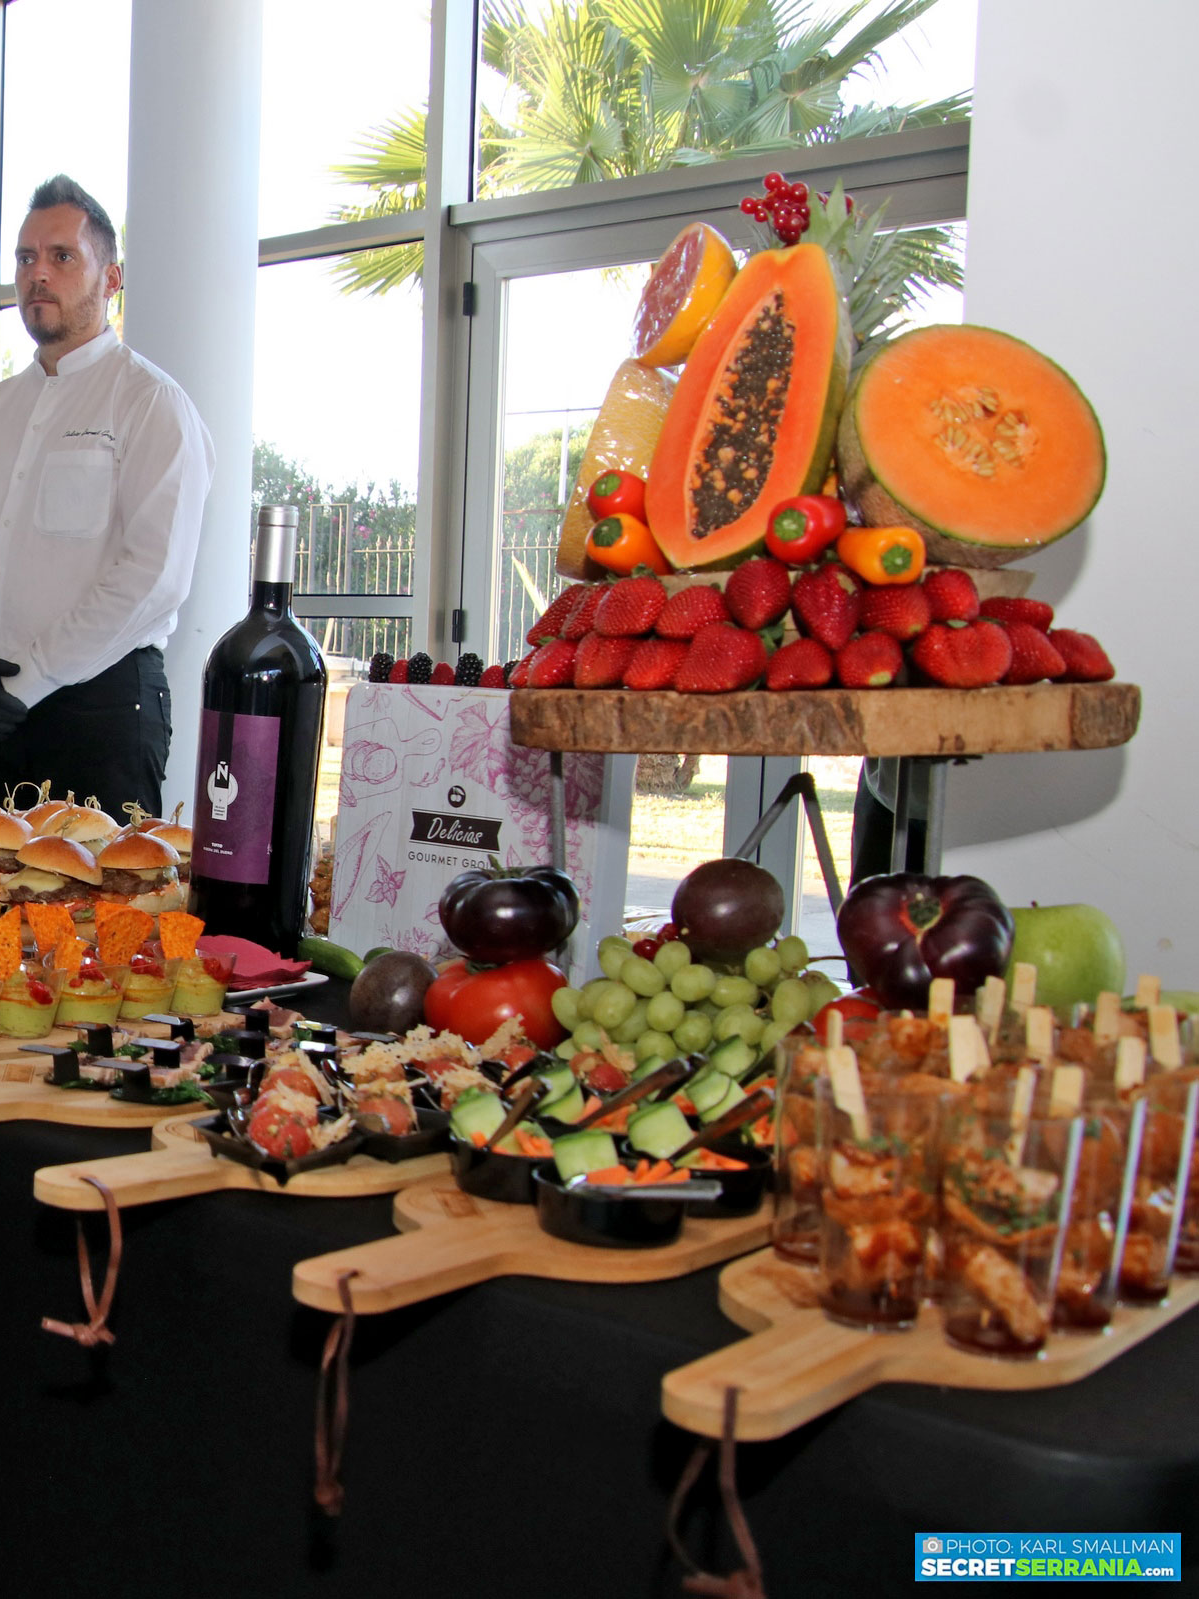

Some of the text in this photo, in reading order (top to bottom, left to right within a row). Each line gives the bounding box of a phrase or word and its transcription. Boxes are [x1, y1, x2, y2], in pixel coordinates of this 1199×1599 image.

[216, 760, 229, 781] Ñ
[426, 817, 484, 844] Delicias
[407, 850, 458, 866] GOURMET
